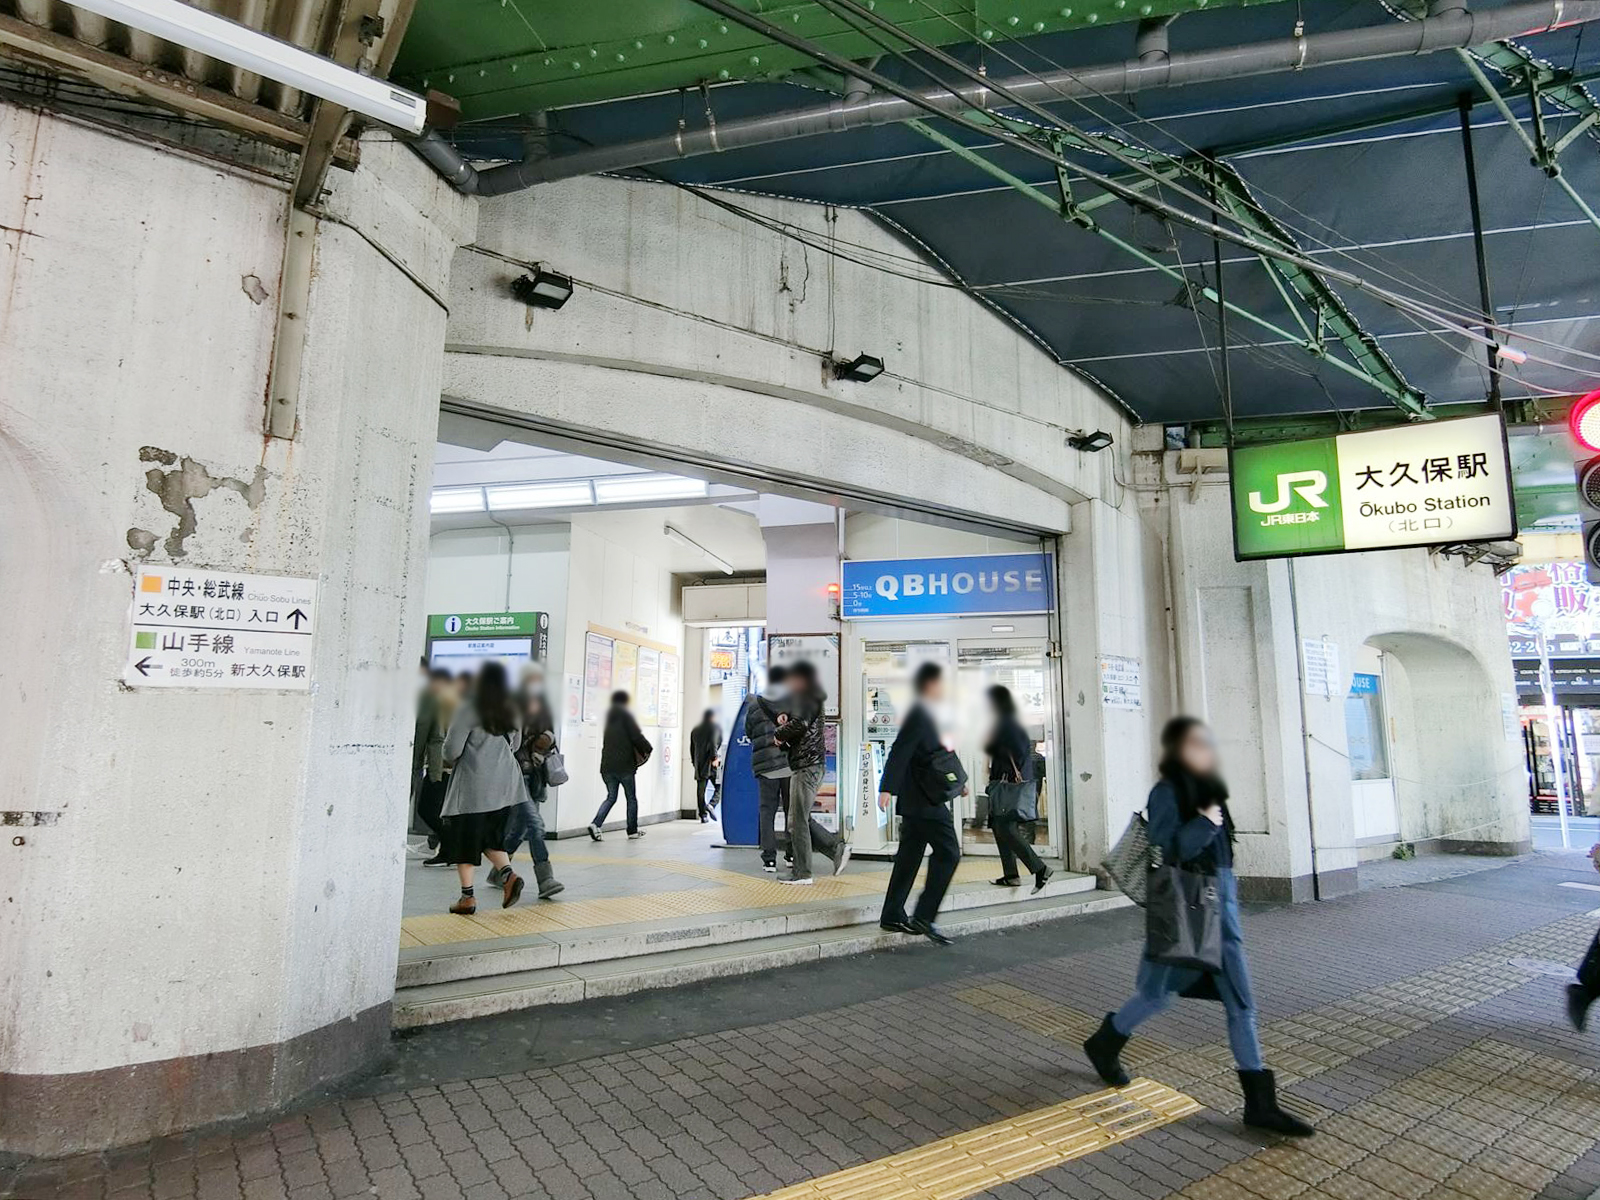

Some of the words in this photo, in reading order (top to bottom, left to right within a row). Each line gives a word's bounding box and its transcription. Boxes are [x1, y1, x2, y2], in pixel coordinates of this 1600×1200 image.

[1355, 452, 1490, 491] 大久保駅
[1248, 469, 1330, 514] JR
[1359, 501, 1418, 518] Ōkubo
[1424, 494, 1491, 512] Station
[1260, 511, 1320, 527] JR東日本
[168, 576, 245, 601] 中央・総武線
[292, 596, 312, 605] Lines
[248, 609, 278, 623] 入口
[162, 632, 234, 655] 山手線
[244, 647, 282, 656] Yamanote
[284, 649, 300, 657] Line
[181, 658, 216, 668] 300m
[231, 663, 306, 679] 新大久保駅
[170, 668, 224, 678] 徒歩約5分
